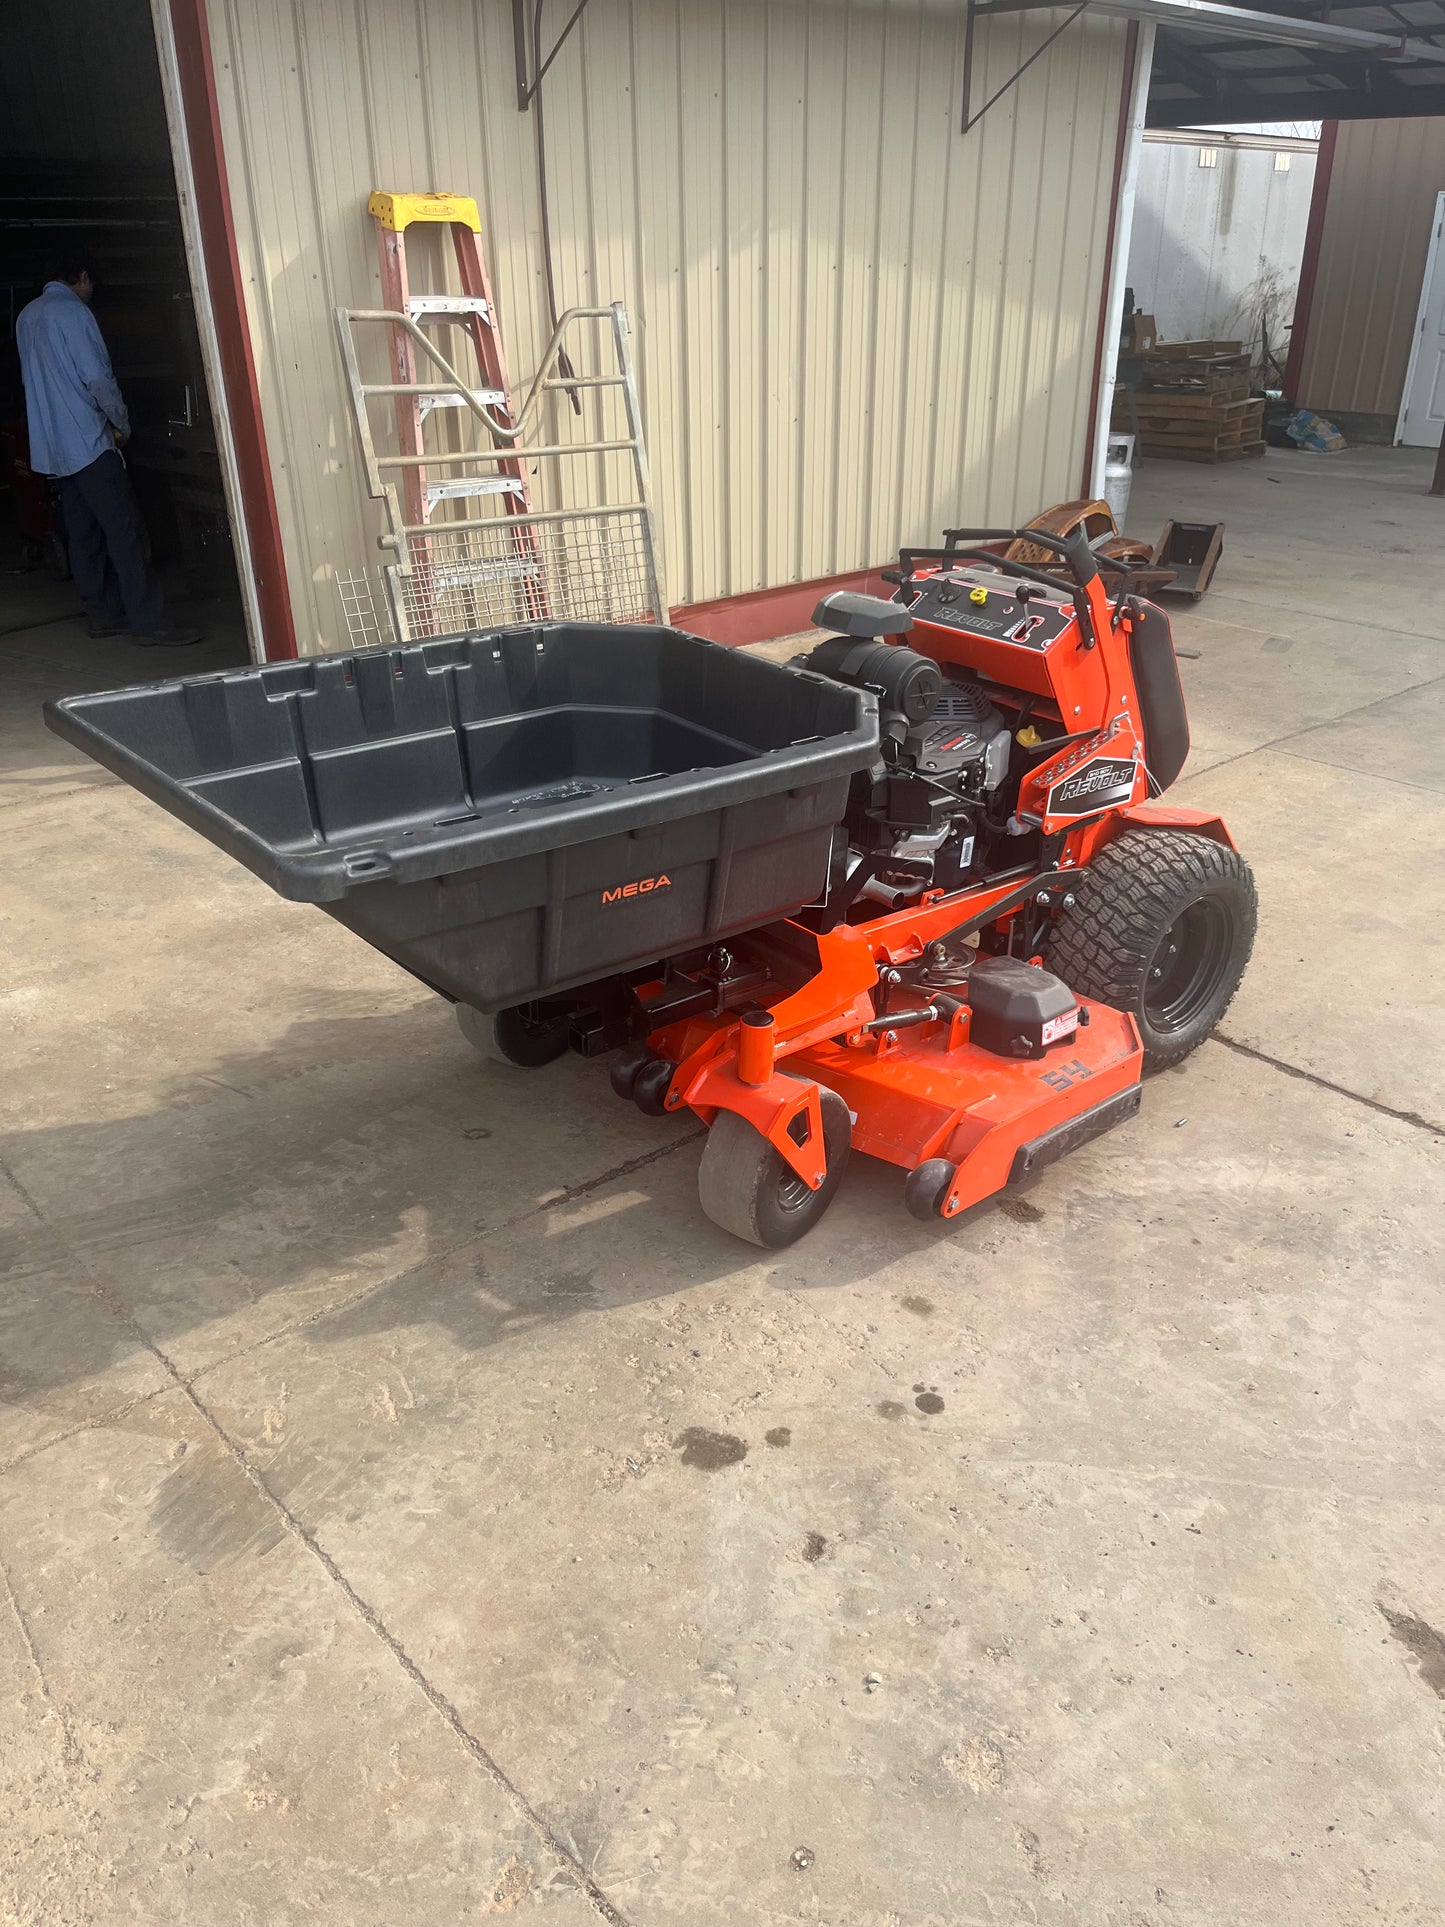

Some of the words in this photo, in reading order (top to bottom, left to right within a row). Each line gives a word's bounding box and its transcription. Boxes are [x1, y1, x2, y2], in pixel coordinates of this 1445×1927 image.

[933, 606, 1003, 631] REVOLT
[1059, 767, 1133, 801] REVOLT
[602, 874, 671, 904] MEGA
[1040, 1060, 1095, 1092] 54
